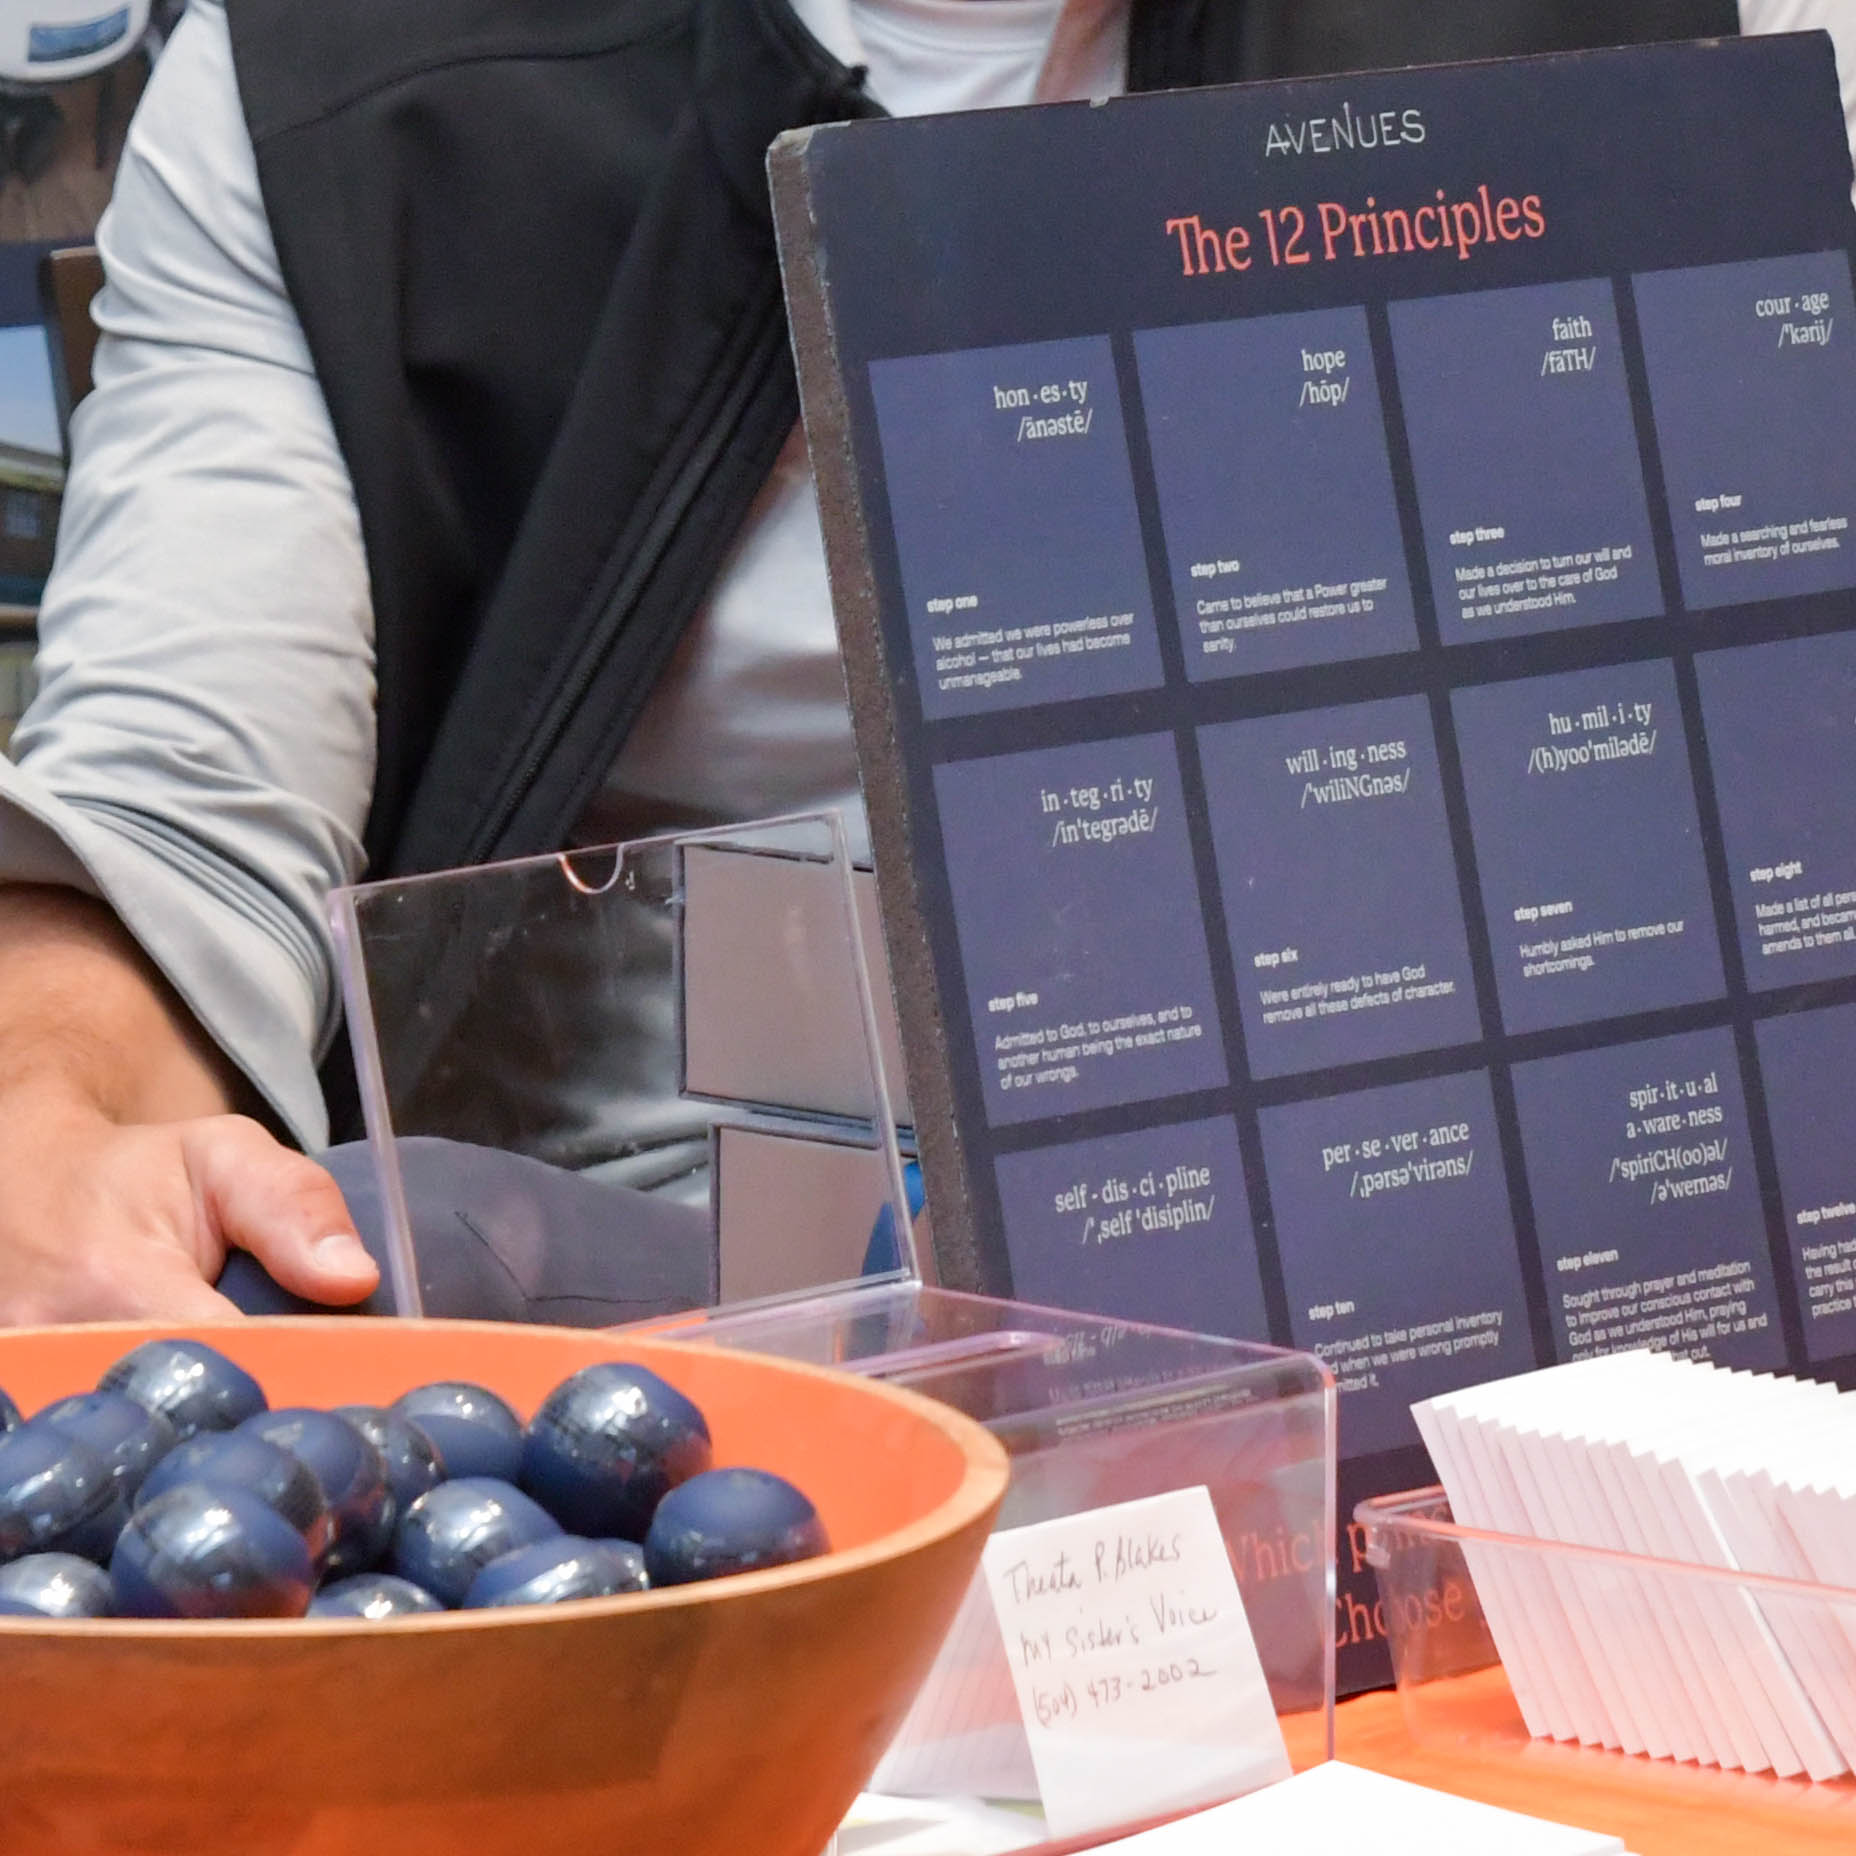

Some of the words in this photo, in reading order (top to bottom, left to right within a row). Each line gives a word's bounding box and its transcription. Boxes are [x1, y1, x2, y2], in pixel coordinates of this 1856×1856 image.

[1265, 102, 1427, 157] AVENUES
[1166, 215, 1253, 277] The
[1258, 205, 1311, 267] 12
[1318, 184, 1546, 261] Principles
[1552, 315, 1593, 342] faith
[1302, 348, 1346, 374] hope
